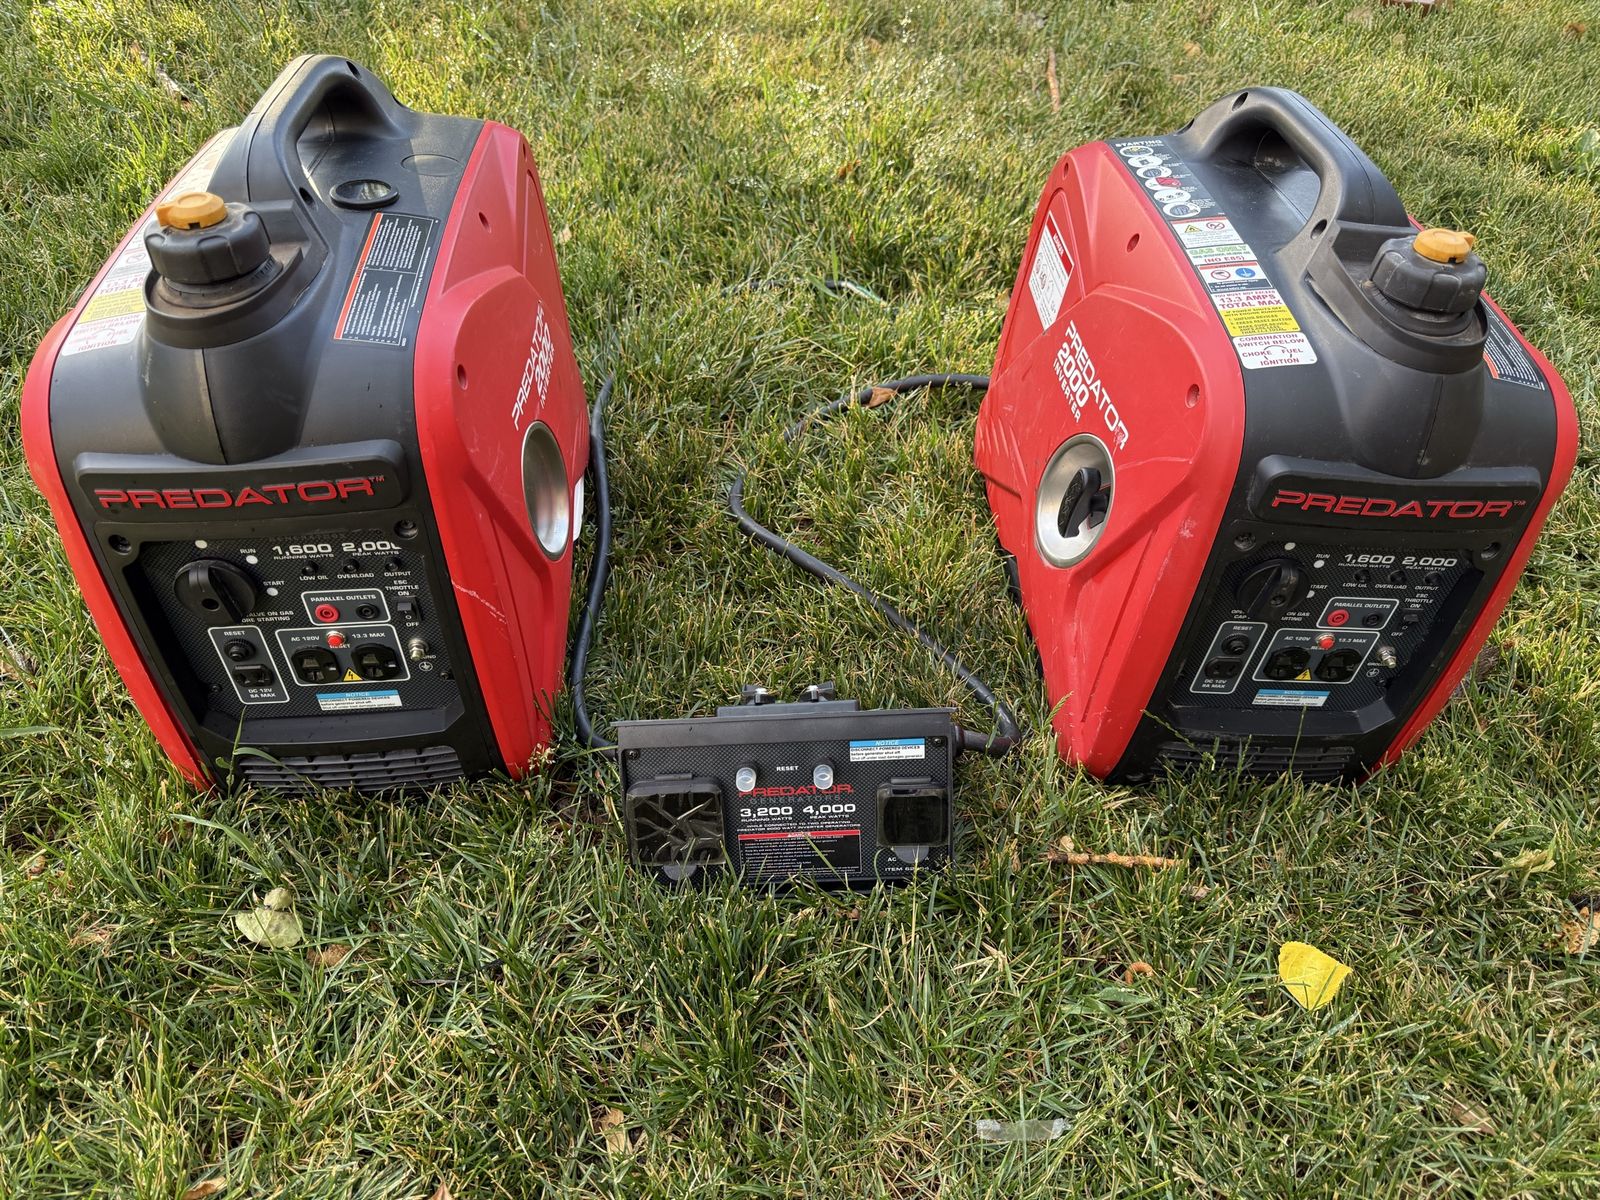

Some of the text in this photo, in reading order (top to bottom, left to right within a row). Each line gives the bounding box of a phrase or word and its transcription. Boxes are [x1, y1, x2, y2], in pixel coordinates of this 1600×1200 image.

[1115, 139, 1162, 147] STARTING
[1189, 247, 1214, 255] GAS
[1219, 302, 1254, 310] TOTAL
[1239, 333, 1298, 342] COMBINATION
[535, 322, 551, 397] 2000
[1242, 350, 1272, 358] CHOKE
[512, 304, 544, 431] PREDATOR
[1260, 358, 1300, 366] IGNITION
[1057, 342, 1090, 408] 2000
[1053, 357, 1082, 423] INVERTER
[1065, 319, 1130, 450] PREDATOR
[94, 476, 375, 509] PREDATOR
[1271, 489, 1514, 519] PREDATOR
[271, 543, 332, 556] 1,600
[1344, 553, 1458, 567] 1,600 2,000
[750, 794, 841, 804] GENERATORS
[740, 803, 856, 818] 3,200 4,000
